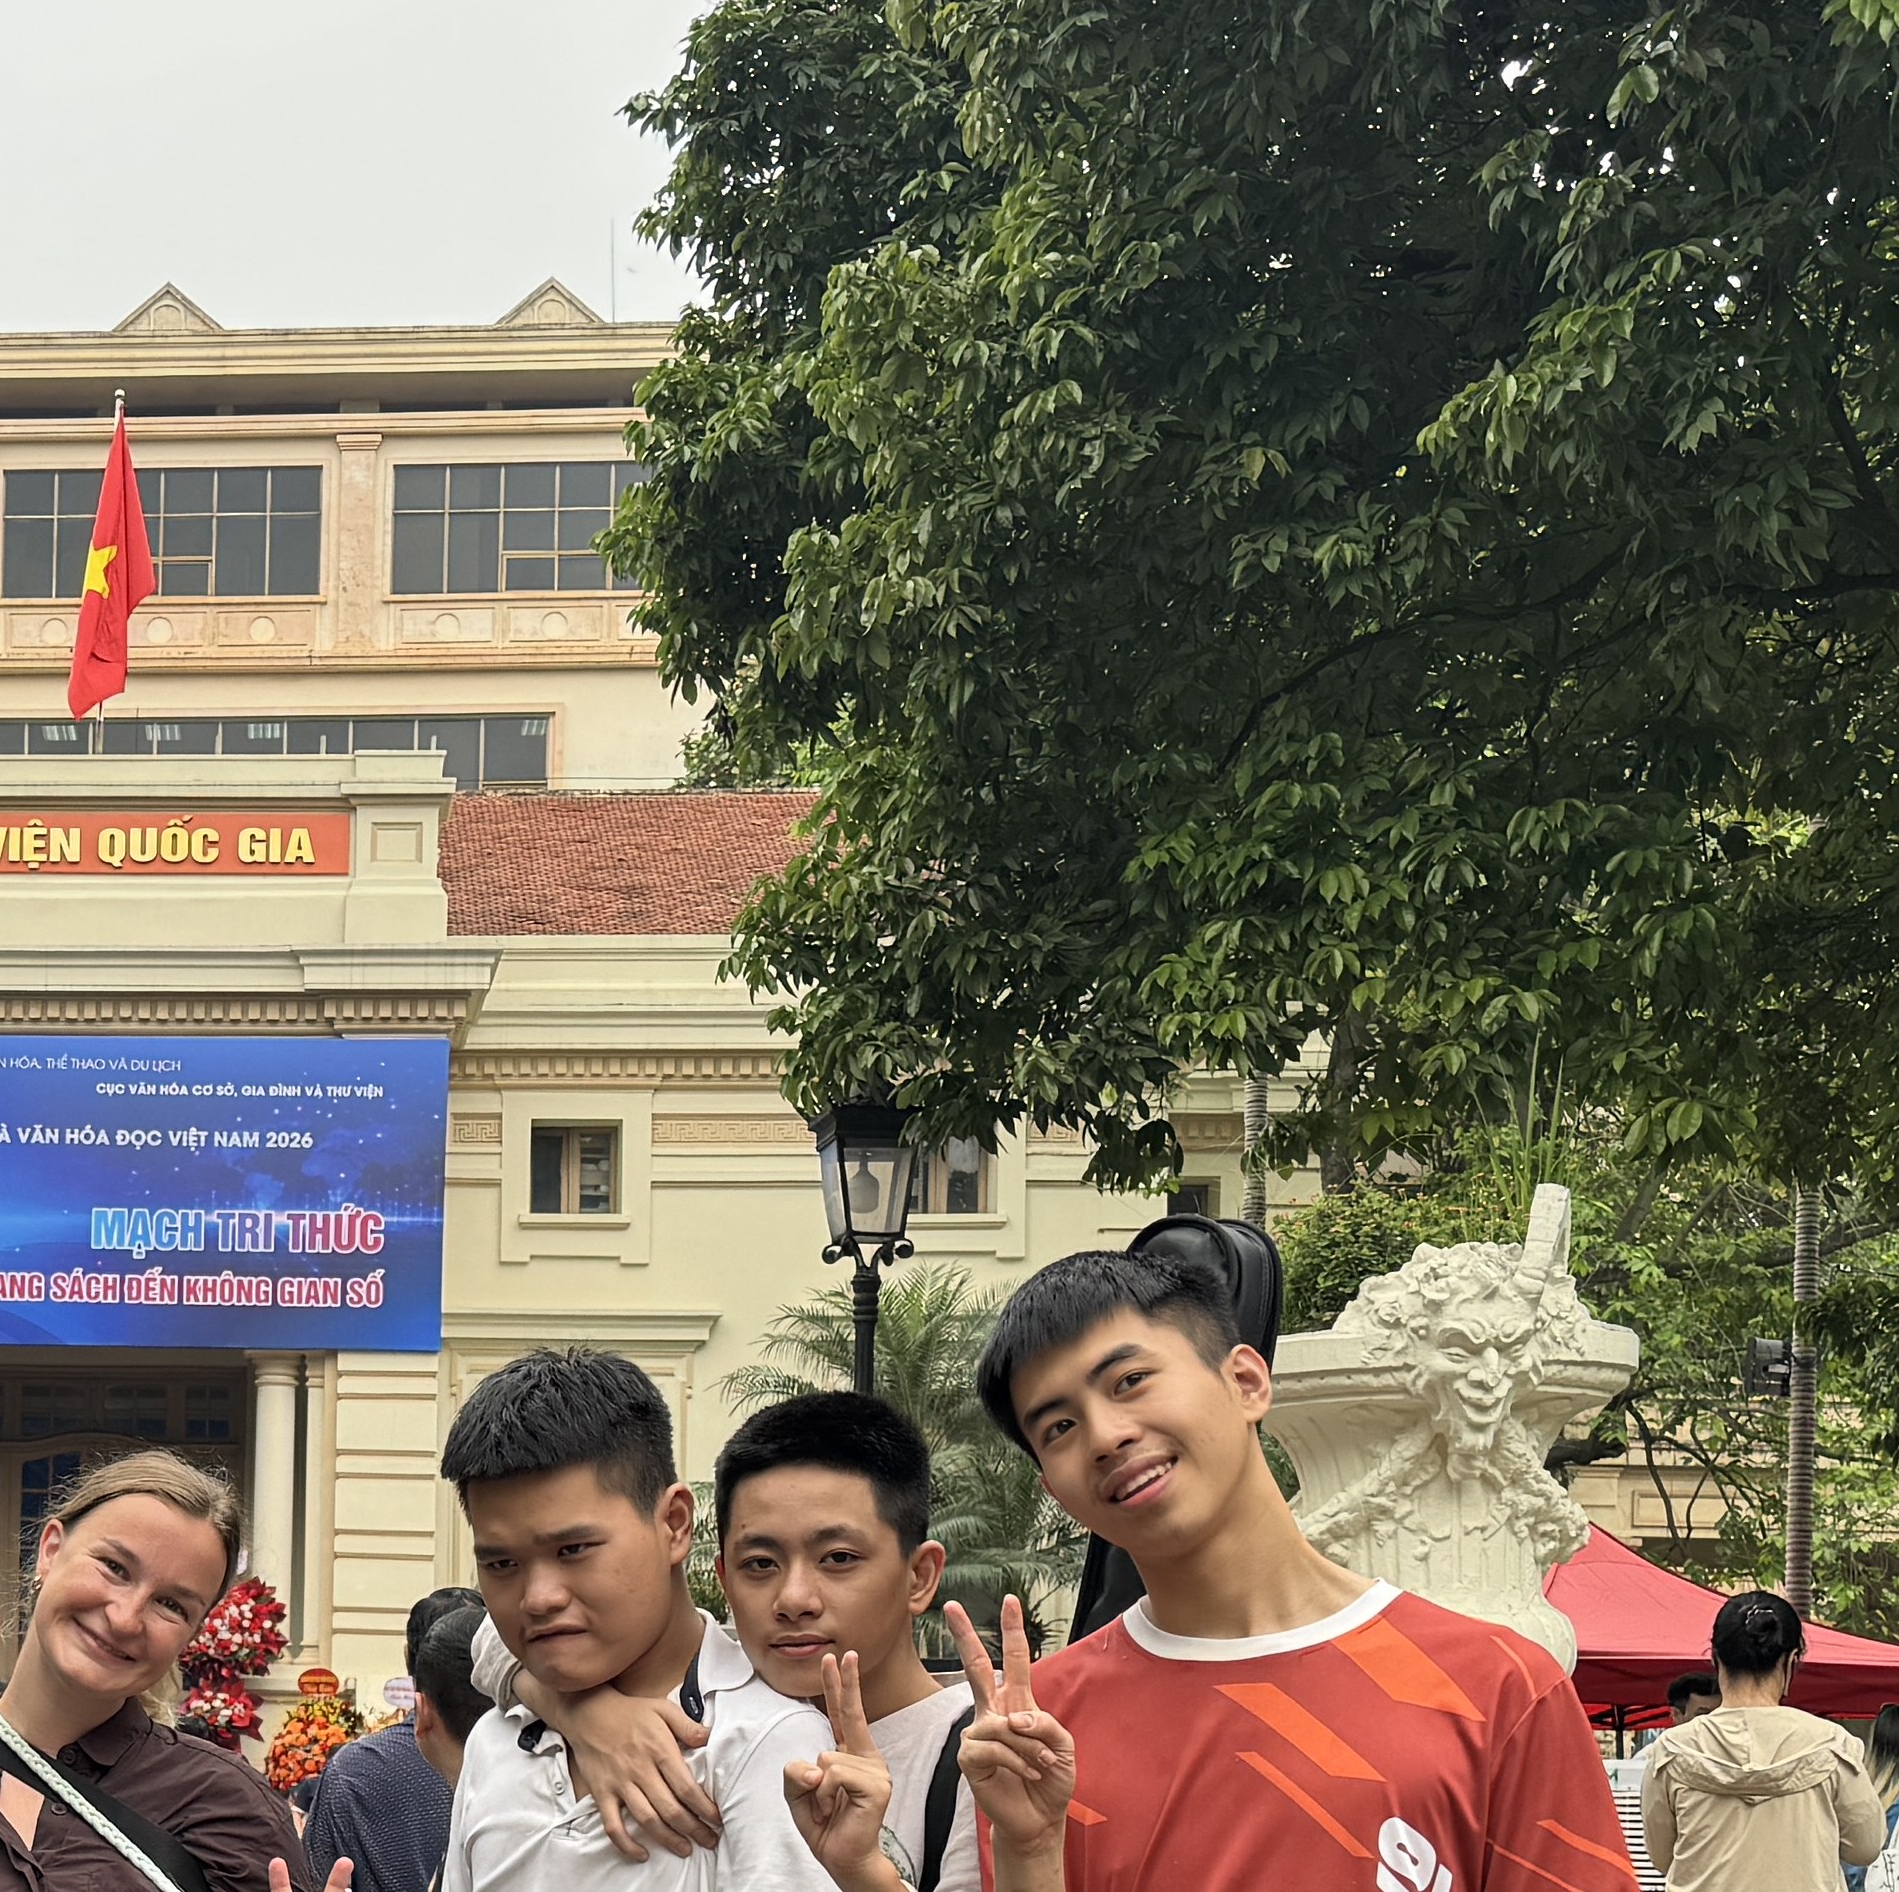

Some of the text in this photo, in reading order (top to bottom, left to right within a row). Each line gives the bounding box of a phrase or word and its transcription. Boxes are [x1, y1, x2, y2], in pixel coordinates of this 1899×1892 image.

[97, 814, 221, 868] QUỐC
[237, 827, 317, 864] GIA
[71, 1058, 106, 1070] THAO
[108, 1057, 128, 1071] VÀ
[130, 1059, 150, 1071] DU
[96, 1082, 125, 1097] CỤC
[128, 1081, 156, 1096] VĂN
[159, 1081, 189, 1096] HÓA
[192, 1083, 213, 1096] CƠ
[241, 1084, 266, 1097] GIA
[268, 1082, 301, 1097] ĐÌNH
[326, 1085, 352, 1097] THƯ
[354, 1083, 384, 1099] VIỆN
[16, 1124, 60, 1145] VĂN
[65, 1124, 110, 1146] HÓA
[115, 1129, 163, 1150] ĐỌC
[167, 1127, 209, 1151] VIỆT
[213, 1131, 260, 1148] NAM
[265, 1131, 314, 1149] 2026
[90, 1203, 385, 1259] MẠCH TRI THỨC
[50, 1267, 120, 1304] SÁCH
[124, 1266, 179, 1305] ĐẾN
[183, 1271, 272, 1305] KHÔNG
[277, 1277, 342, 1307] GIAN
[346, 1268, 385, 1309] SỐ
